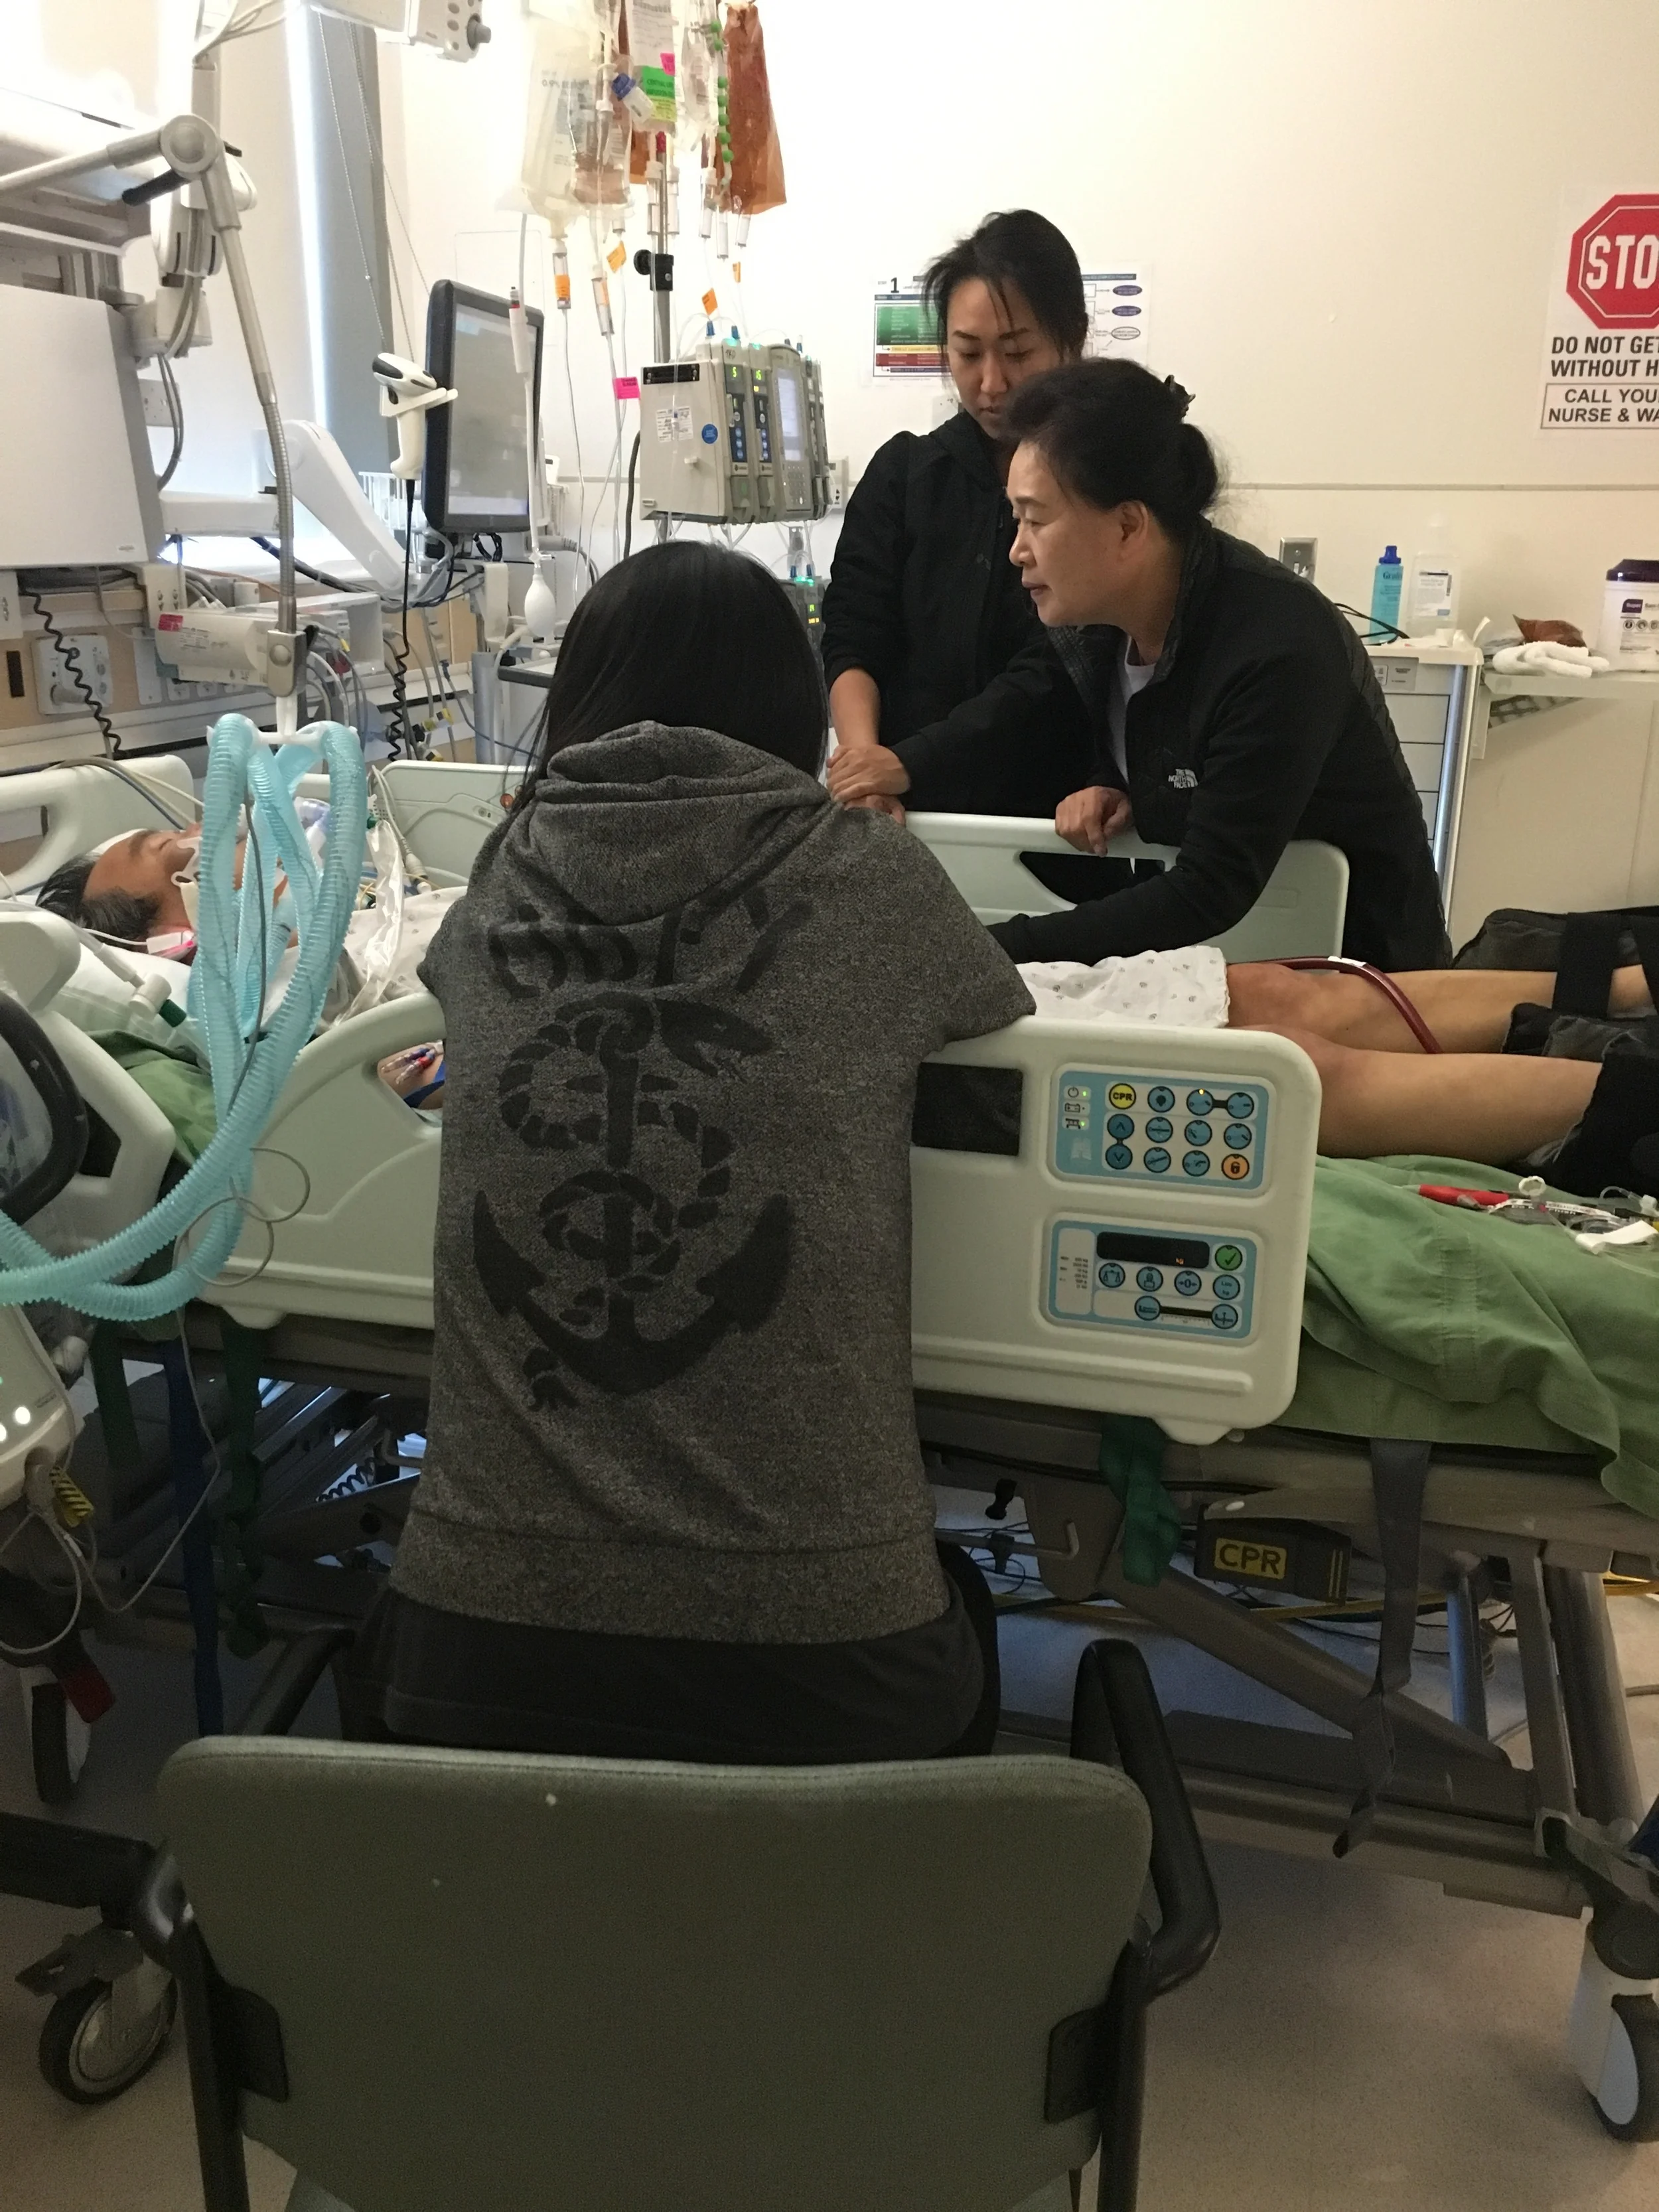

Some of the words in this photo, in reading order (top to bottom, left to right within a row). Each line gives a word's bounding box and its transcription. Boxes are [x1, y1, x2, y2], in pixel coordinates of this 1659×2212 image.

[1585, 235, 1659, 289] STO
[890, 277, 900, 293] 1
[1551, 336, 1578, 354] DO
[1584, 336, 1625, 354] NOT
[1551, 359, 1641, 377] WITHOUT
[1565, 388, 1612, 403] CALL
[1619, 388, 1659, 403] YOU
[1548, 407, 1612, 422] NURSE
[1617, 407, 1630, 422] &
[1112, 1092, 1133, 1101] CPR
[1219, 1543, 1282, 1576] CPR
